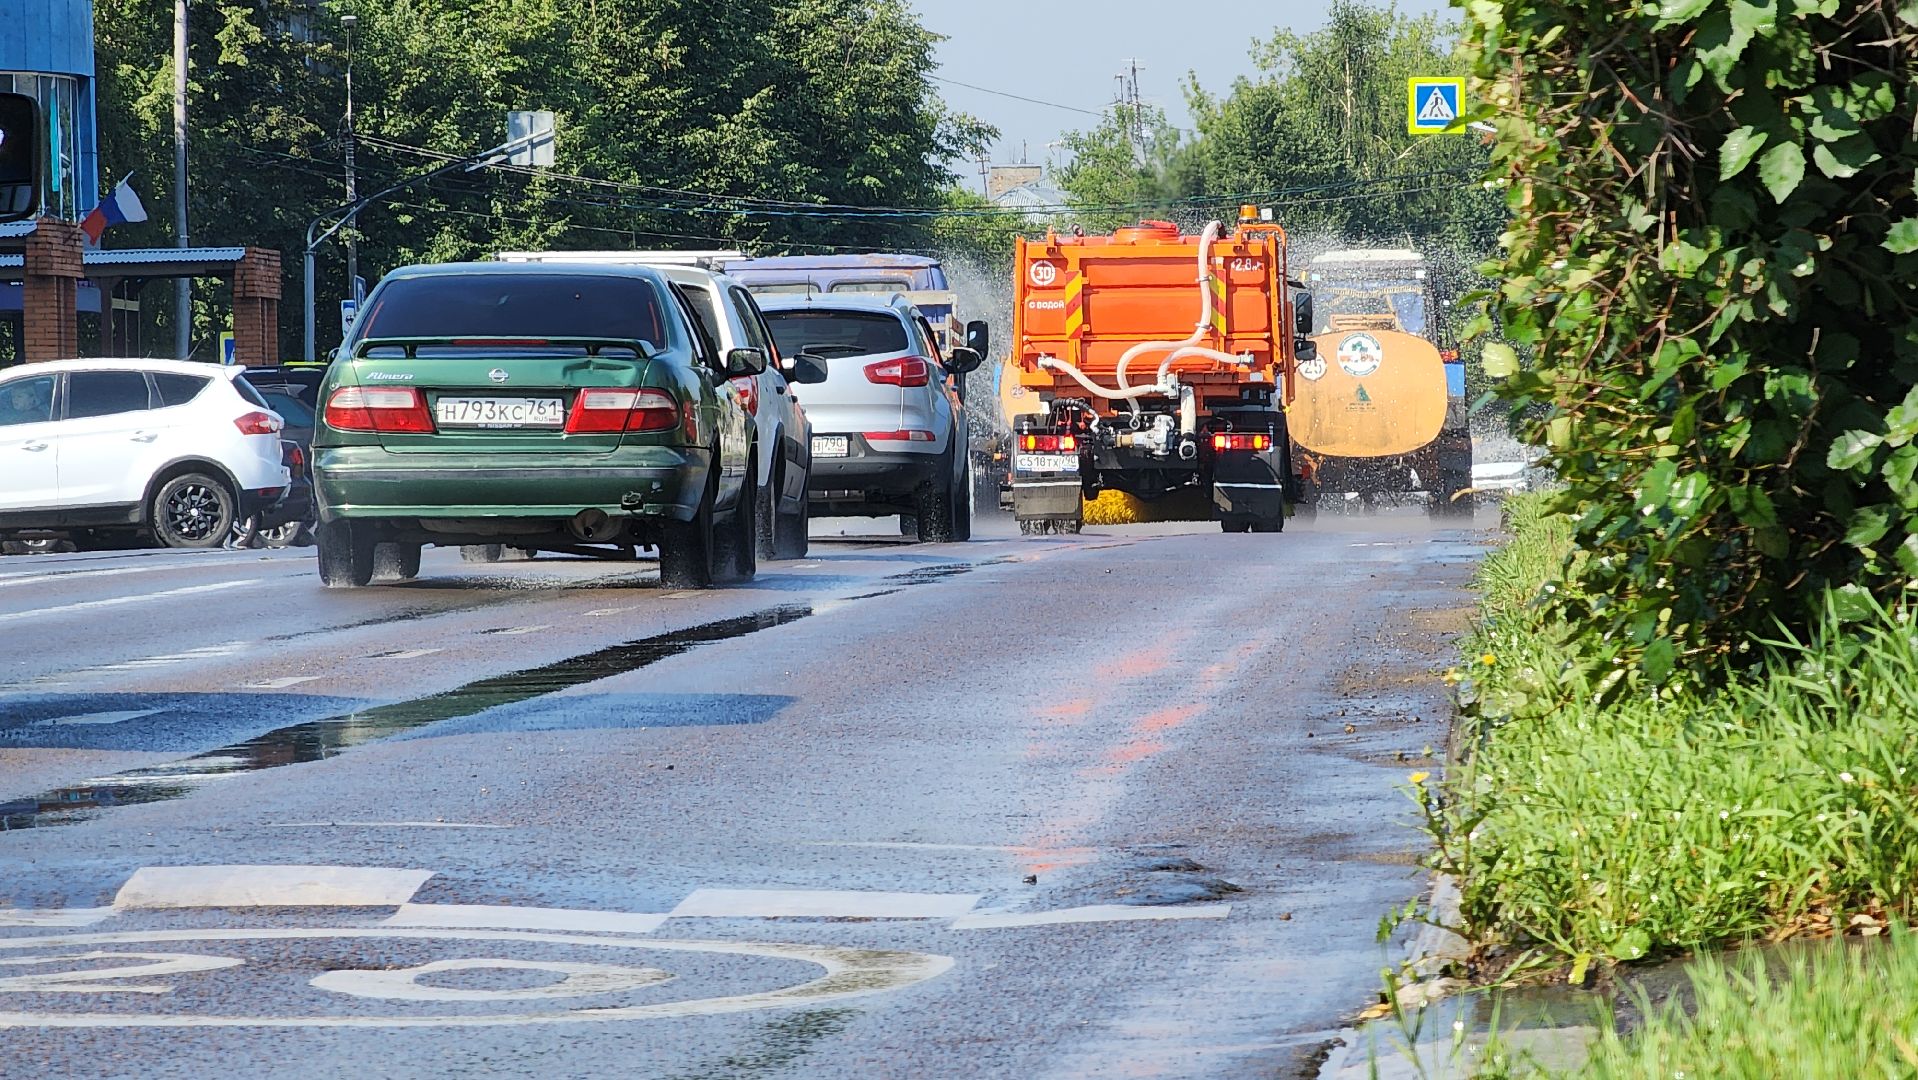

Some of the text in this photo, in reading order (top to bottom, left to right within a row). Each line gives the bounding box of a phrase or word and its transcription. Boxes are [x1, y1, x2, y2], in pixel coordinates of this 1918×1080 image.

[366, 372, 415, 381] Almera
[527, 400, 557, 415] 761
[823, 438, 842, 447] 790
